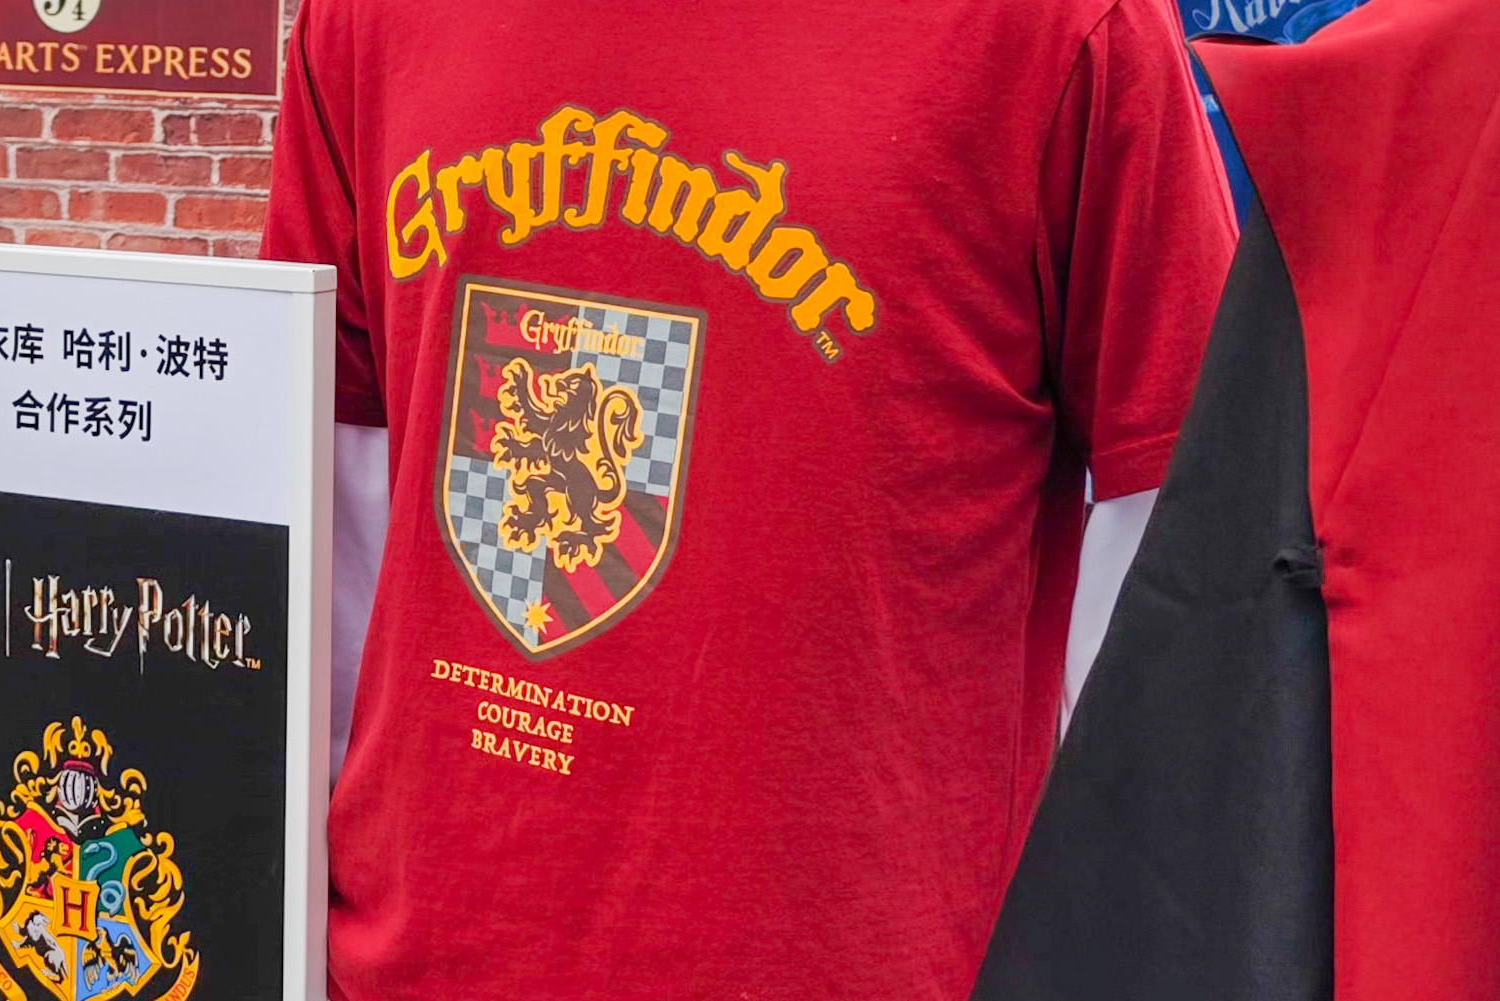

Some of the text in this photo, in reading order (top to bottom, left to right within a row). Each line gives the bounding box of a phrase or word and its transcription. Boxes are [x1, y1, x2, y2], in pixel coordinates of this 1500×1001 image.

[96, 43, 252, 81] EXPRESS
[385, 105, 876, 333] Gryffindor
[63, 327, 229, 381] 哈利·波特
[520, 309, 645, 359] Gryffindor
[12, 389, 153, 442] 合作系列
[24, 575, 134, 660] Harry
[135, 577, 252, 675] Potter
[430, 659, 635, 727] DETERMINATION
[477, 701, 574, 744] COURAGE
[471, 728, 575, 776] BRAVERY
